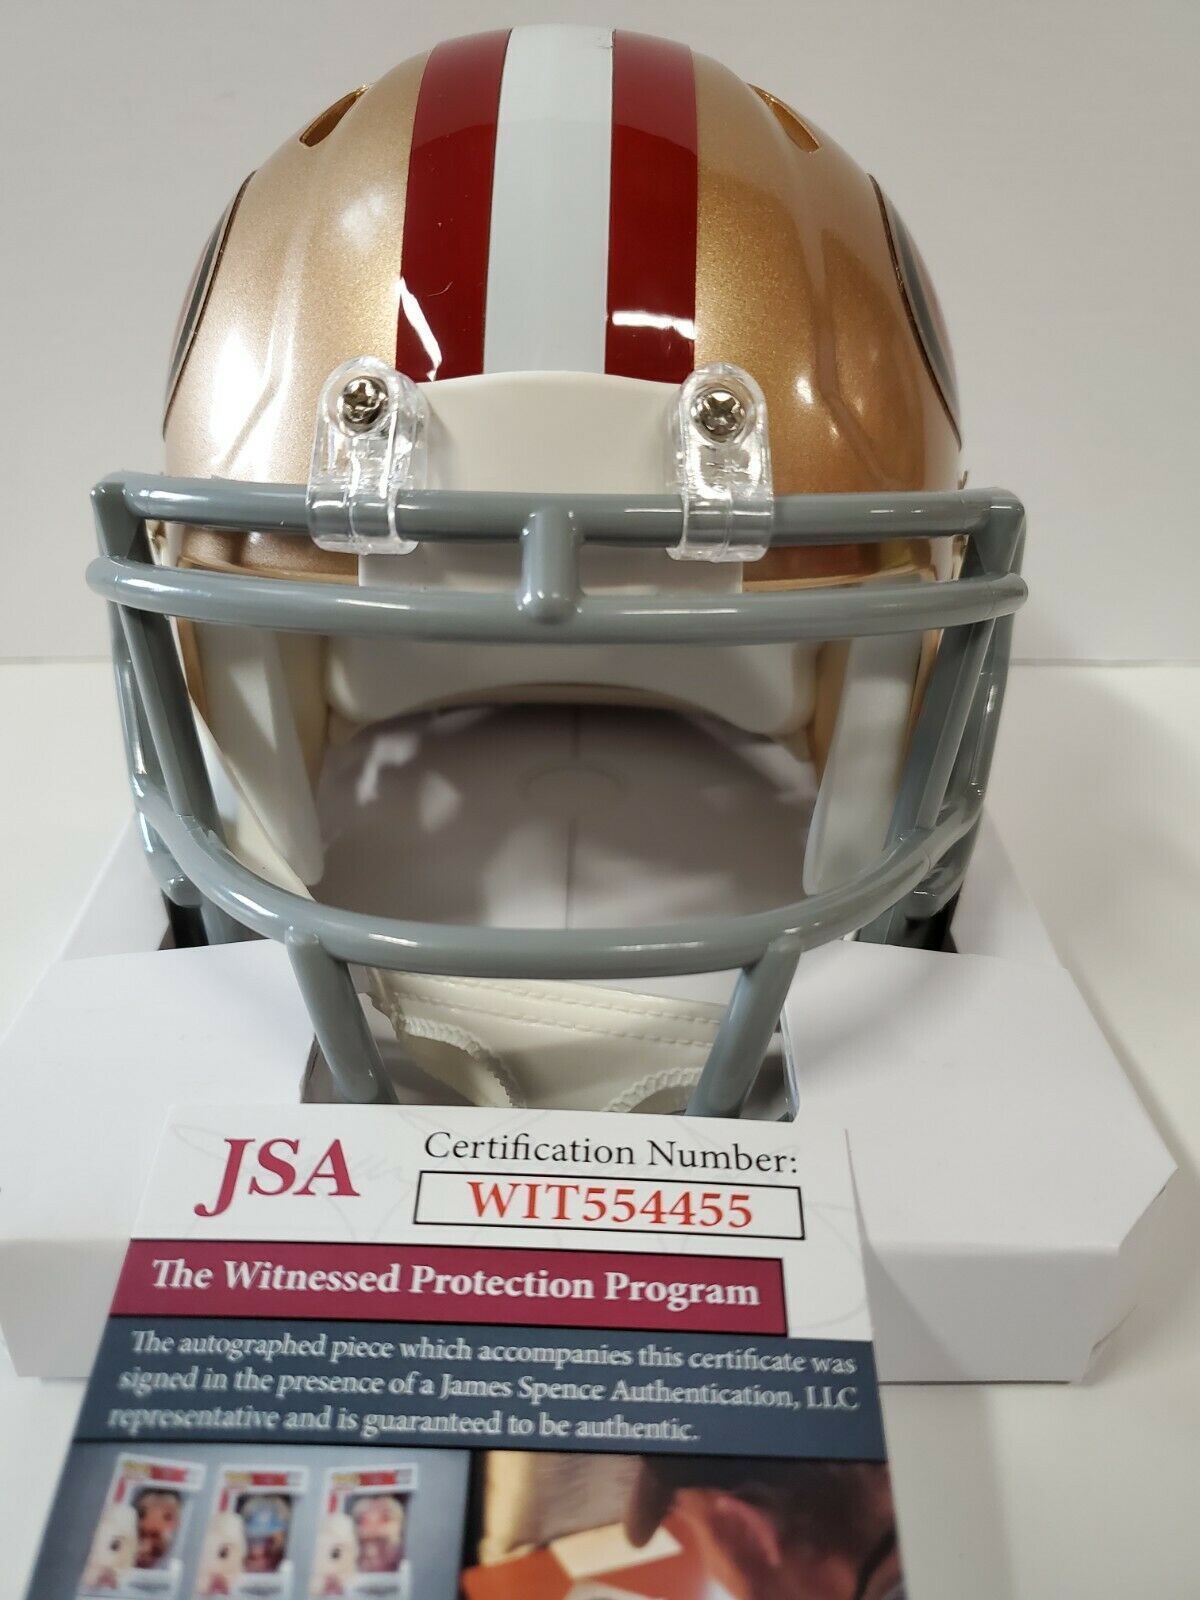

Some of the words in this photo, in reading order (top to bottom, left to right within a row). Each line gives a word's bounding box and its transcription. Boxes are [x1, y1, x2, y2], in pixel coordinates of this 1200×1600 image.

[424, 1131, 635, 1167] Certification
[647, 1139, 799, 1173] Number:
[194, 1138, 361, 1217] JSA
[467, 1181, 753, 1228] WIT554455
[153, 1259, 212, 1289] The
[224, 1261, 401, 1293] Witnessed
[411, 1265, 595, 1299] Protection
[605, 1272, 760, 1312] Program
[131, 1329, 177, 1354] The
[179, 1333, 325, 1359] autographed
[331, 1337, 393, 1363] piece
[400, 1338, 471, 1361] which
[477, 1345, 632, 1369] accompanies
[639, 1345, 682, 1368] this
[688, 1347, 805, 1373] certificate
[811, 1357, 856, 1375] was
[119, 1367, 197, 1392] signed
[203, 1368, 226, 1390] in
[233, 1368, 272, 1391] the
[276, 1375, 384, 1398] presence
[388, 1372, 417, 1394] of
[418, 1378, 434, 1394] a
[441, 1376, 512, 1400] James
[517, 1377, 605, 1405] Spence
[611, 1381, 799, 1410] Authentication,
[805, 1387, 858, 1409] LLC
[108, 1407, 280, 1434] representative
[285, 1407, 331, 1429] and
[337, 1408, 357, 1430] is
[363, 1410, 501, 1440] guaranteed
[508, 1415, 533, 1434] to
[540, 1414, 569, 1436] be
[575, 1416, 699, 1440] authentic.
